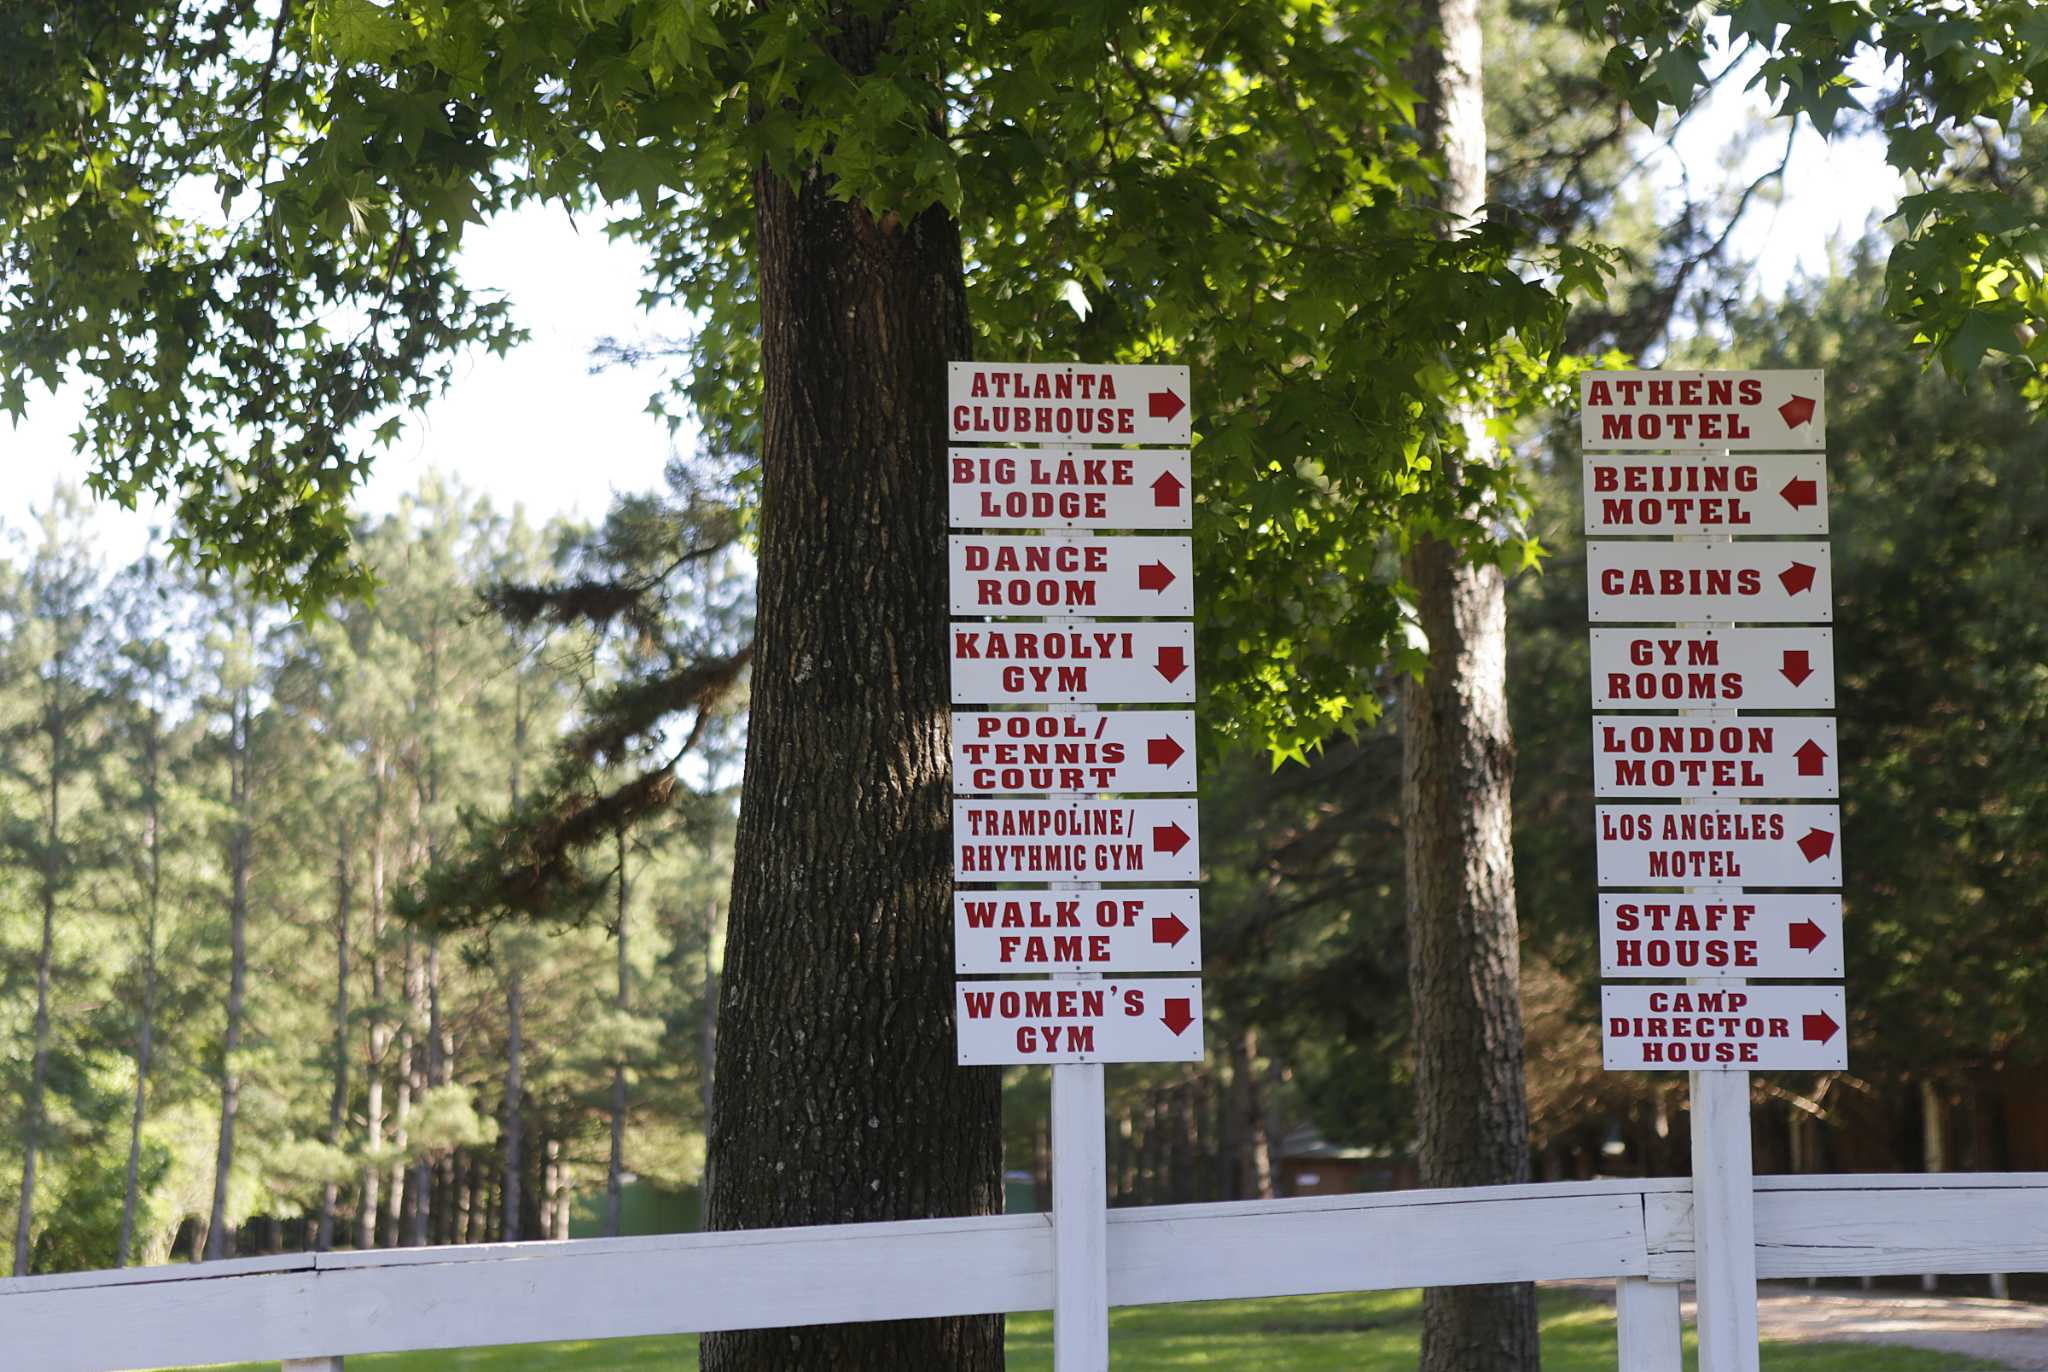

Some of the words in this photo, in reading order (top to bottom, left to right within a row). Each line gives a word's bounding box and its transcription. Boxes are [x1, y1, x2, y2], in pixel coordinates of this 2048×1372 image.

[971, 372, 1116, 400] ATLANTA
[1588, 379, 1762, 406] ATHENS
[953, 405, 1135, 433] CLUBHOUSE
[1602, 413, 1750, 440] MOTEL
[953, 458, 1017, 485] BIG
[1030, 459, 1134, 486] LAKE
[1594, 466, 1758, 492] BEIJING
[980, 491, 1106, 518] LODGE
[1602, 498, 1751, 524] MOTEL
[965, 545, 1108, 572] DANCE
[977, 579, 1096, 606] ROOM
[1601, 569, 1761, 596] CABINS
[955, 632, 1133, 660] KAROLYI
[1630, 640, 1719, 666] GYM
[1003, 666, 1088, 693] GYM
[1608, 672, 1743, 700] ROOMS
[978, 717, 1108, 739] POOL/
[1603, 726, 1774, 753] LONDON
[962, 743, 1125, 765] TENNIS
[972, 768, 1116, 789] COURT
[1615, 760, 1764, 786] MOTEL
[967, 809, 1135, 838] TRAMPOLINE/
[1602, 815, 1652, 841] LOS
[1663, 815, 1784, 840] ANGELES
[961, 844, 1087, 872] RHYTHMIC
[1095, 844, 1144, 871] GYM
[1649, 851, 1741, 877] MOTEL
[965, 901, 1080, 928] WALK
[1096, 900, 1144, 928] OF
[1616, 904, 1756, 932] STAFF
[1000, 936, 1111, 962] FAME
[1616, 940, 1758, 967] HOUSE
[965, 986, 1145, 1018] WOMEN'S
[1649, 992, 1748, 1013] CAMP
[1017, 1025, 1094, 1053] GYM
[1610, 1018, 1790, 1037] DIRECTOR
[1643, 1042, 1759, 1062] HOUSE
